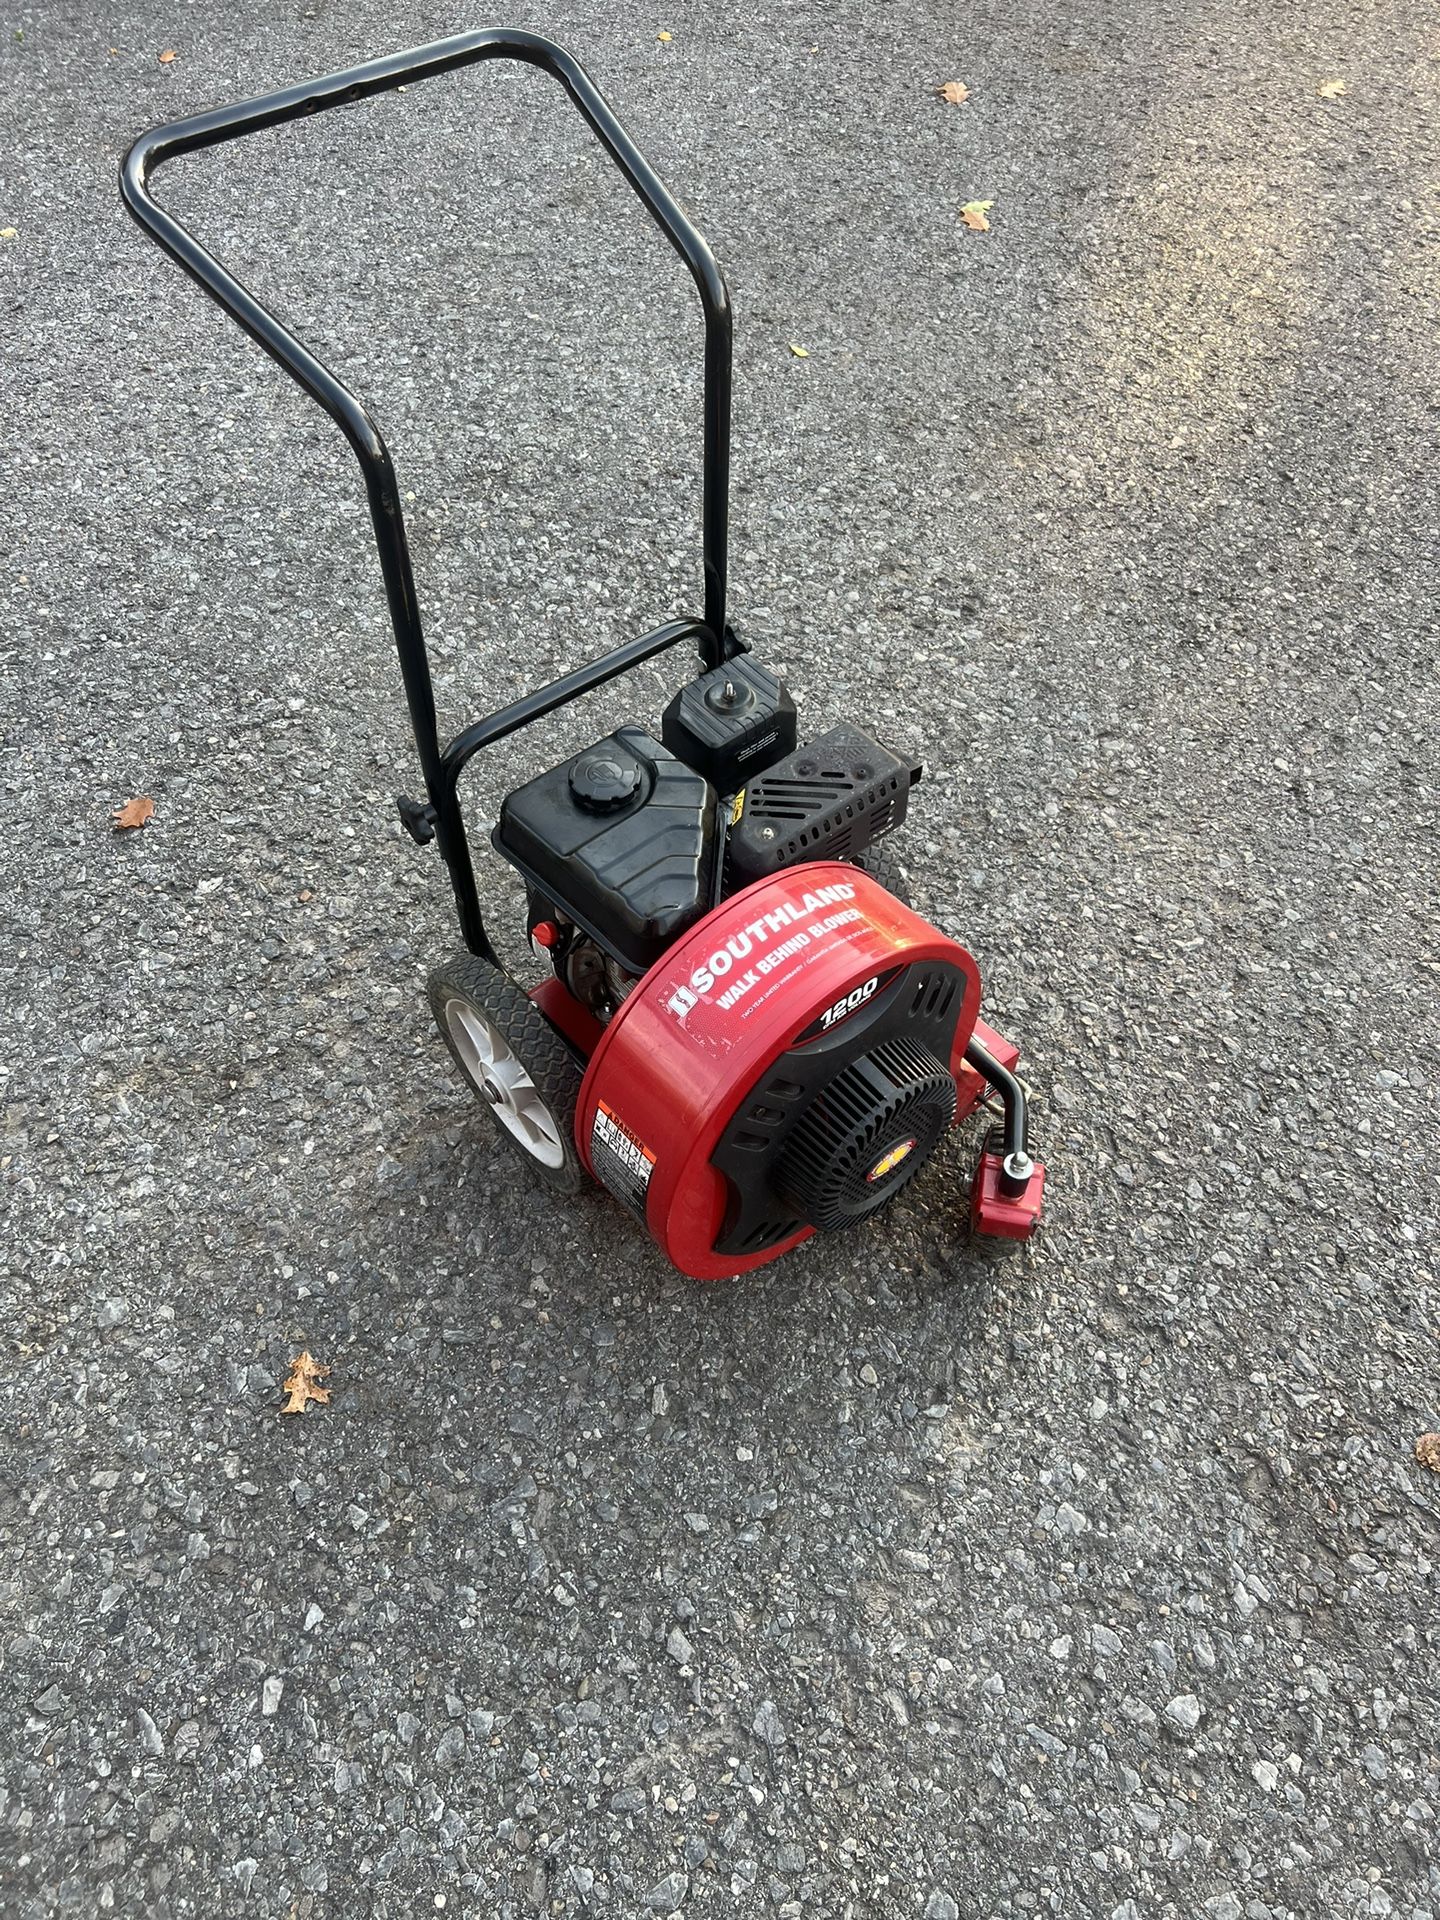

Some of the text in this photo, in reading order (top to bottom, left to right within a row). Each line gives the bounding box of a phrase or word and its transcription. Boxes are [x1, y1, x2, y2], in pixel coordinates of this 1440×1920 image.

[691, 884, 855, 994] SOUTHLAND
[715, 969, 761, 1010] WALK
[756, 932, 811, 975] BEHIND
[807, 908, 864, 938] BLOWER
[741, 1006, 754, 1019] TWO
[753, 997, 765, 1010] YEAR
[820, 977, 878, 1024] 1200
[613, 1116, 644, 1150] DANGER
